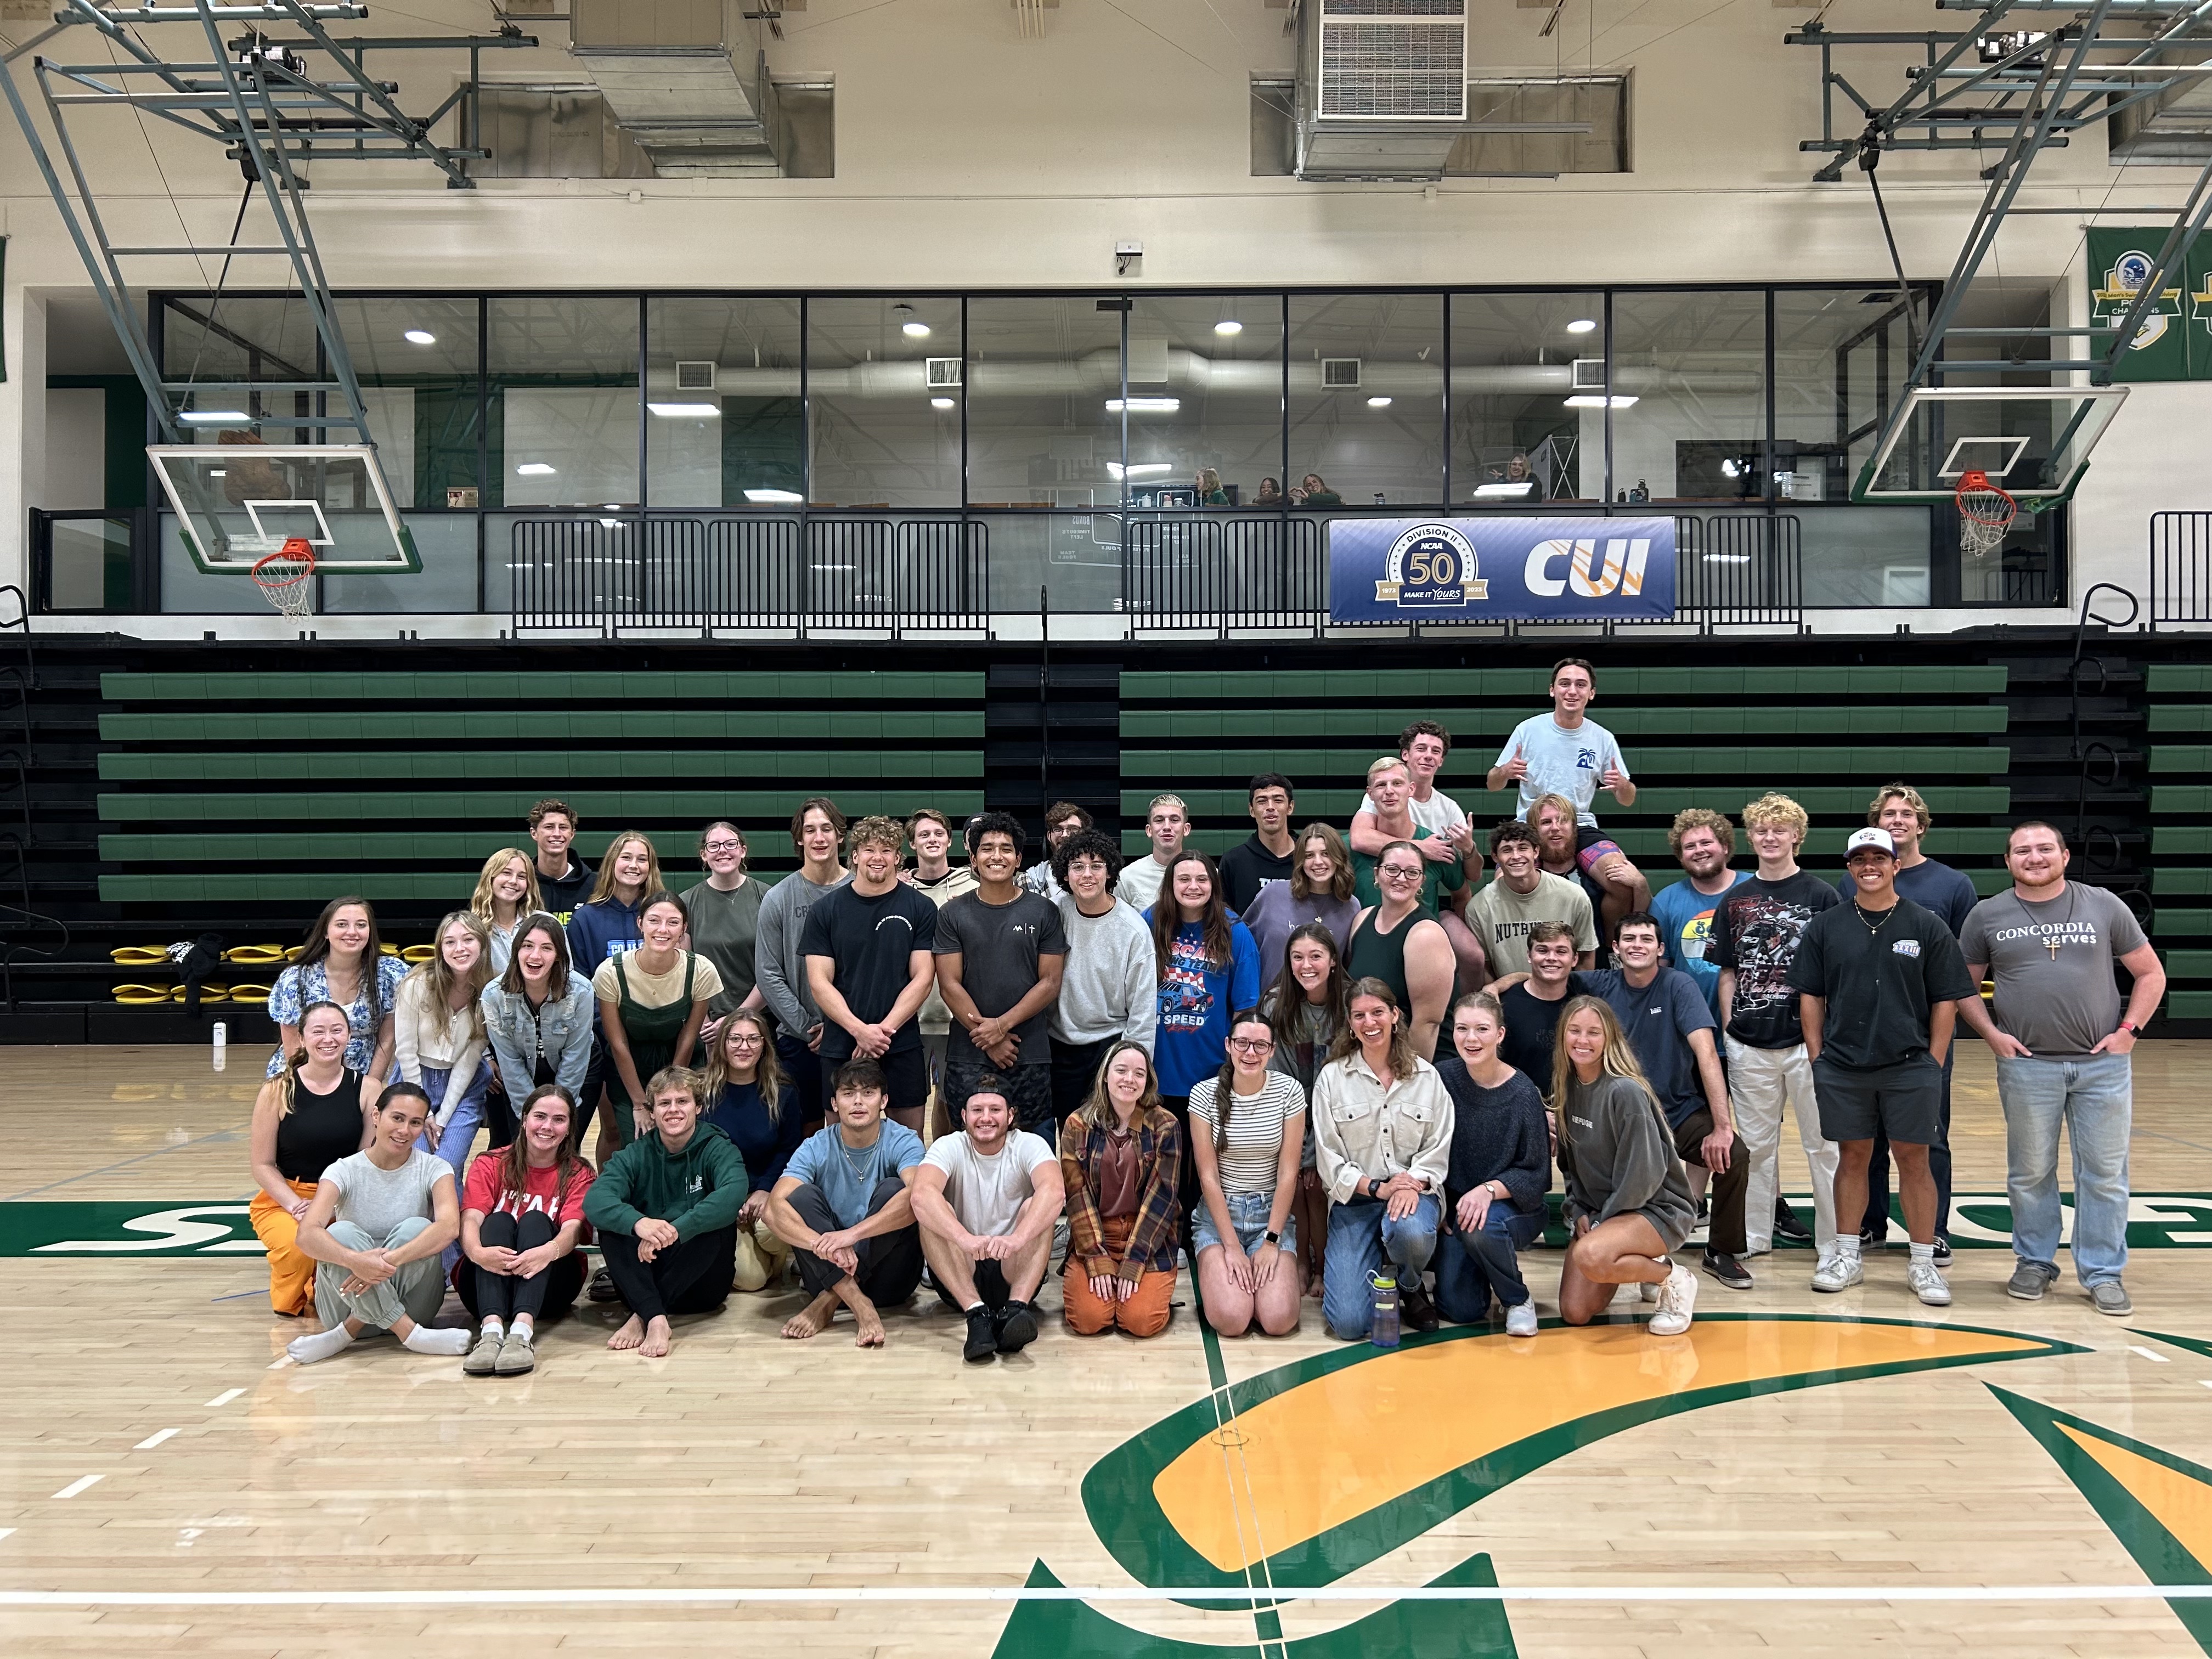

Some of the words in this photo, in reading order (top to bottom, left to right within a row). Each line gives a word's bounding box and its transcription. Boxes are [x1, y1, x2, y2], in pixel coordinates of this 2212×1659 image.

[1407, 528, 1448, 543] DIVISION
[1409, 552, 1454, 585] 50
[1524, 539, 1651, 597] CUI
[1432, 587, 1461, 600] YOURS
[1996, 922, 2096, 941] CONCORDIA
[2042, 934, 2097, 945] serves
[1164, 1014, 1204, 1026] SPEED
